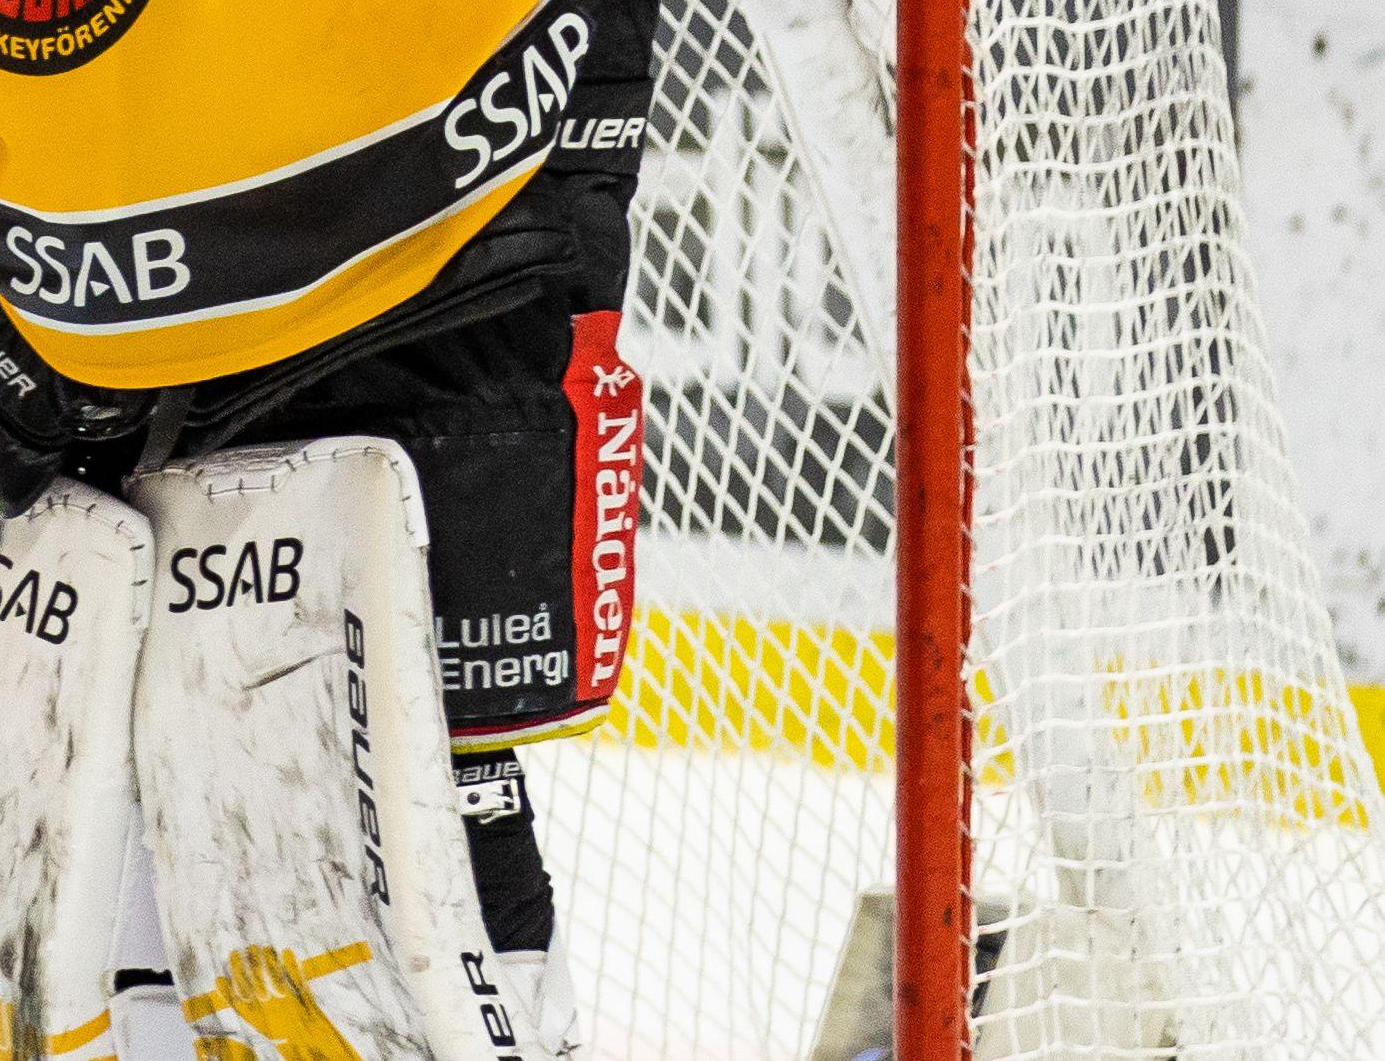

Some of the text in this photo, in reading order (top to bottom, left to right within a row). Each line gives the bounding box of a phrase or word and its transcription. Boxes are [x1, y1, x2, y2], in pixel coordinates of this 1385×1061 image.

[559, 117, 647, 150] UER
[5, 227, 191, 308] SSAB
[169, 536, 305, 615] SSAB
[435, 602, 552, 648] Luleå
[346, 609, 392, 909] BAUER
